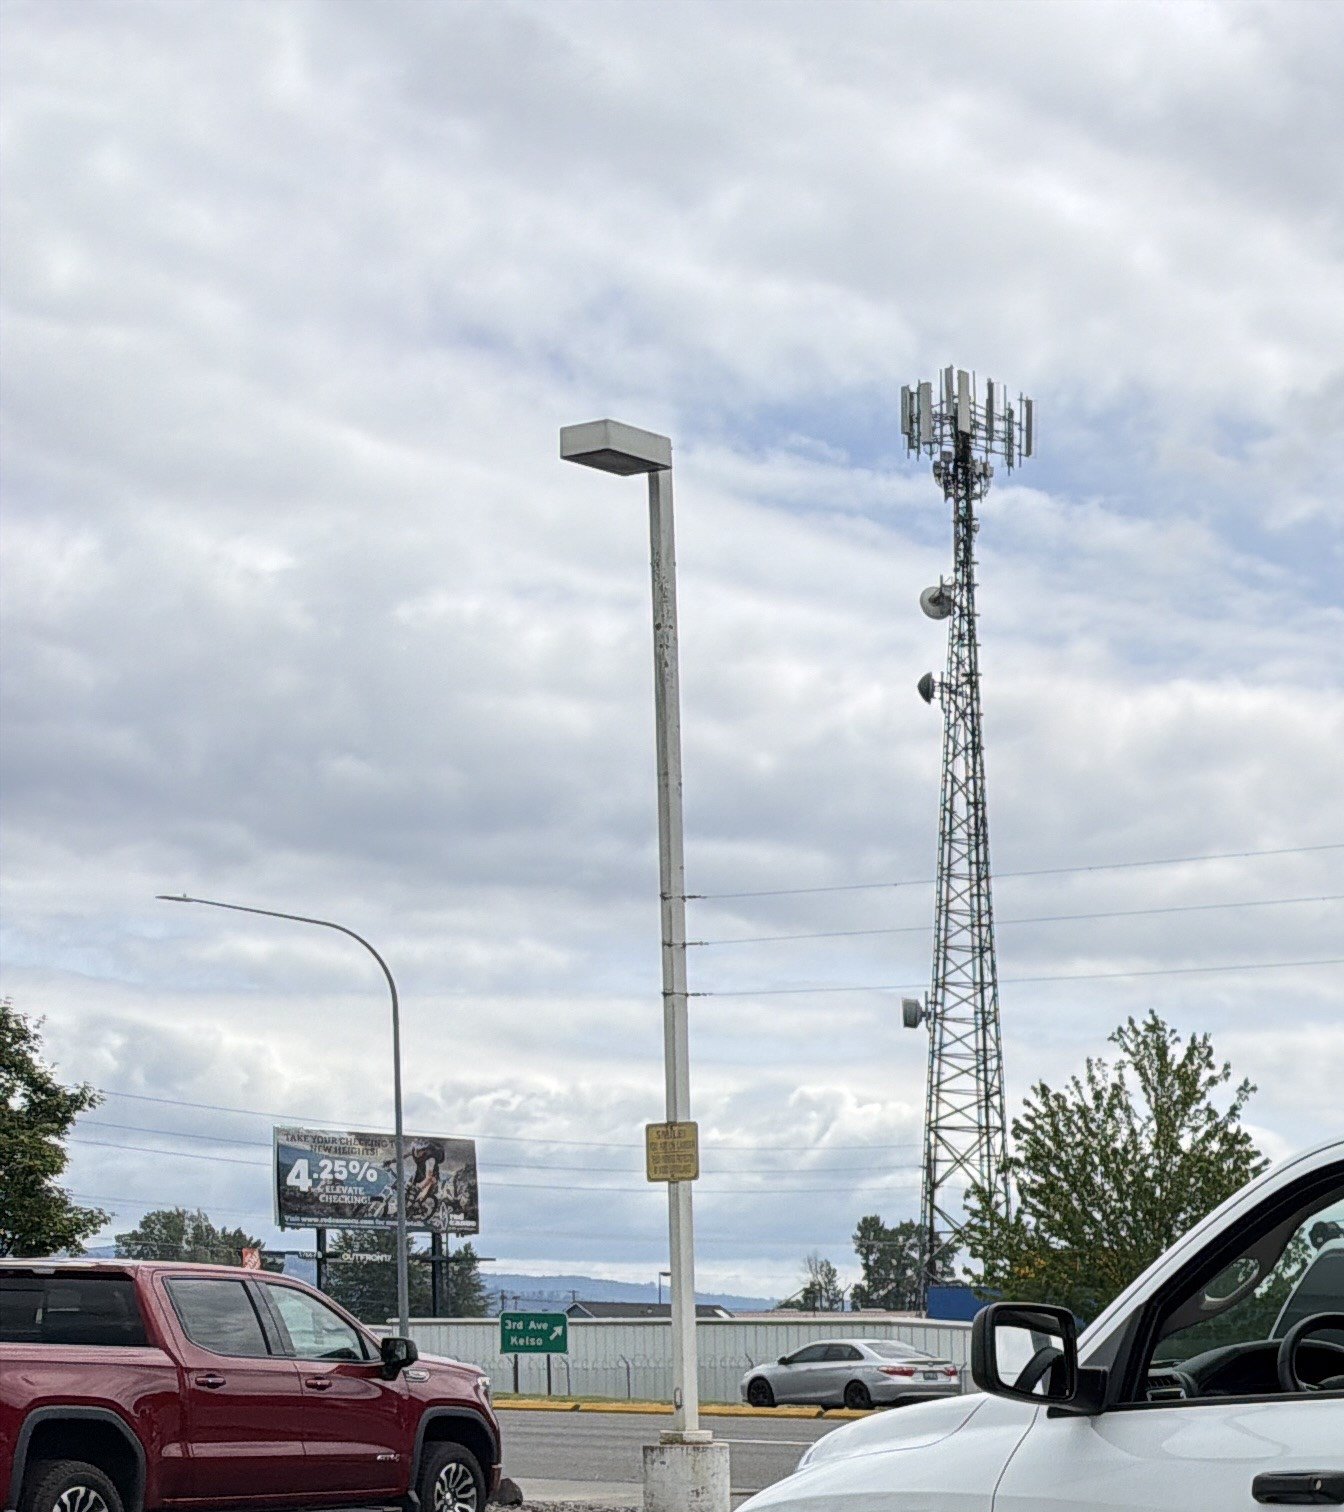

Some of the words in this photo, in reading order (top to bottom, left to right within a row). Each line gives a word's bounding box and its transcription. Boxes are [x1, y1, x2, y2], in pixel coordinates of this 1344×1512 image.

[284, 1134, 309, 1142] TAKE
[310, 1136, 337, 1145] YOUR
[339, 1138, 388, 1148] CHECKING
[310, 1144, 332, 1153] NEW
[286, 1158, 378, 1192] 4.25%
[325, 1186, 365, 1195] ELEVATE
[505, 1320, 524, 1330] 3rd
[529, 1321, 548, 1330] Ave
[510, 1335, 543, 1346] Kelso
